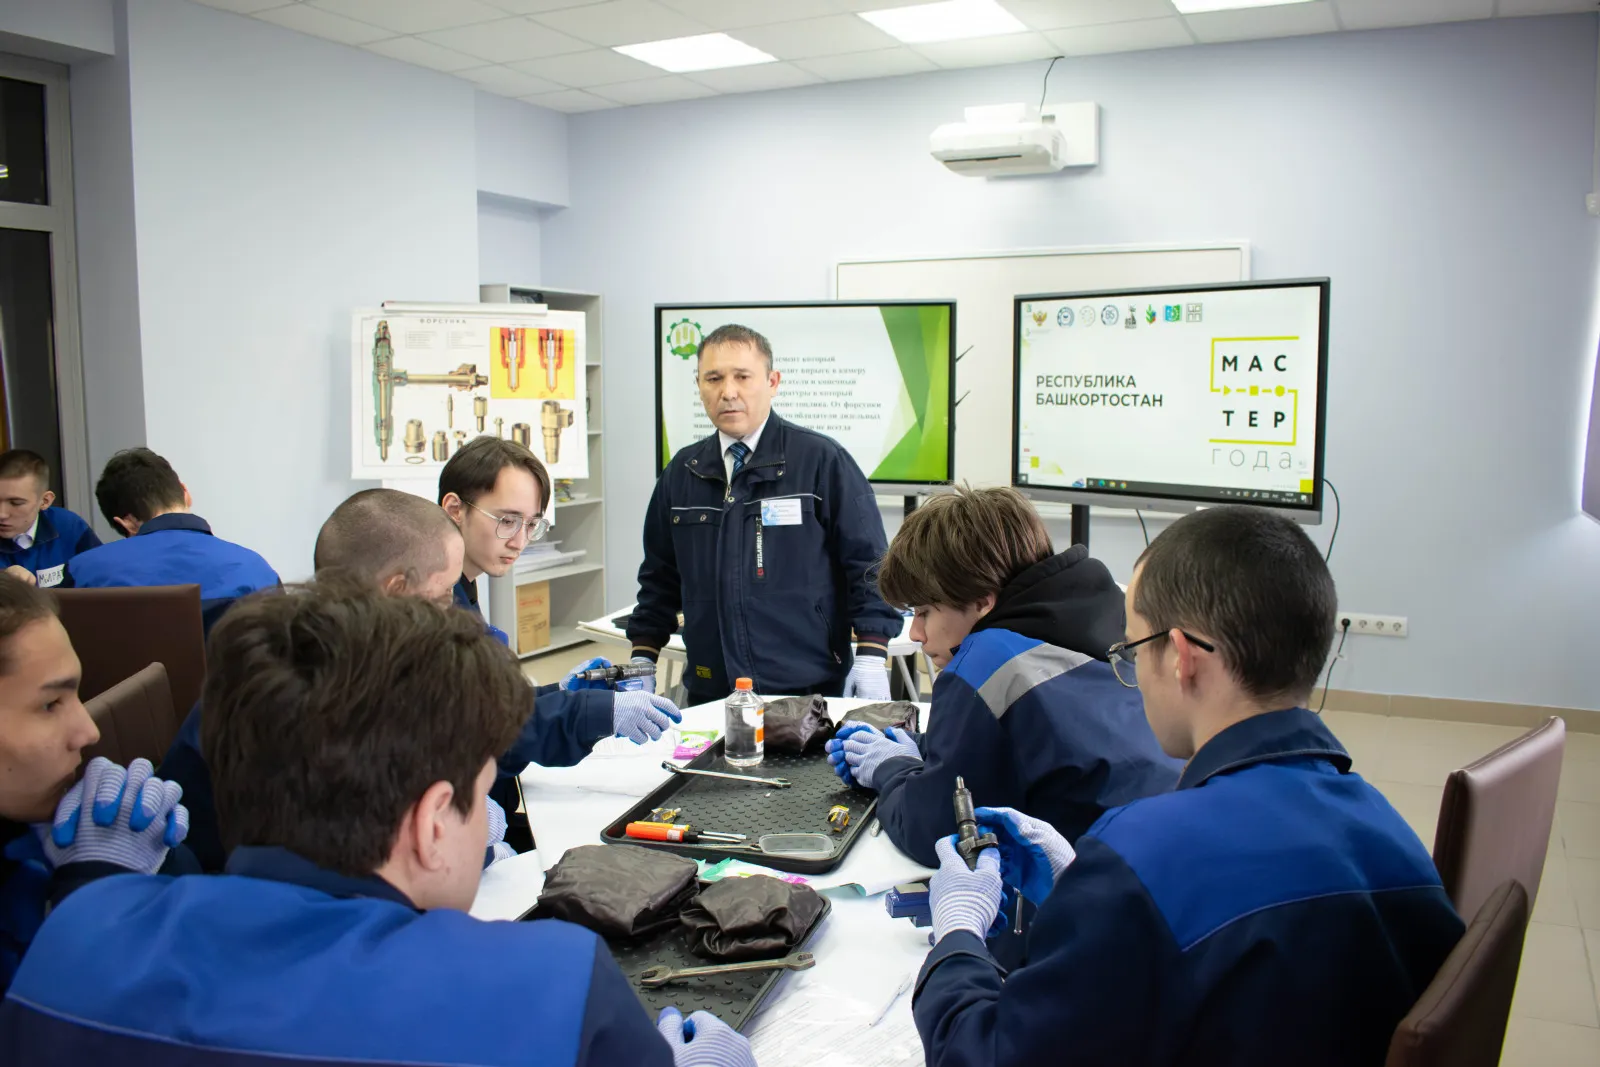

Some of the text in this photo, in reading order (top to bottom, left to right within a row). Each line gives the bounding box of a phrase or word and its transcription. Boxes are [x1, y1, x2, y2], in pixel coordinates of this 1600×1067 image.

[1222, 355, 1287, 372] МАС
[1036, 375, 1137, 389] РЕСПУБЛИКА
[1036, 393, 1163, 407] БАШКОРТОСТАН
[1222, 411, 1286, 428] ТЕР
[1211, 448, 1292, 472] года
